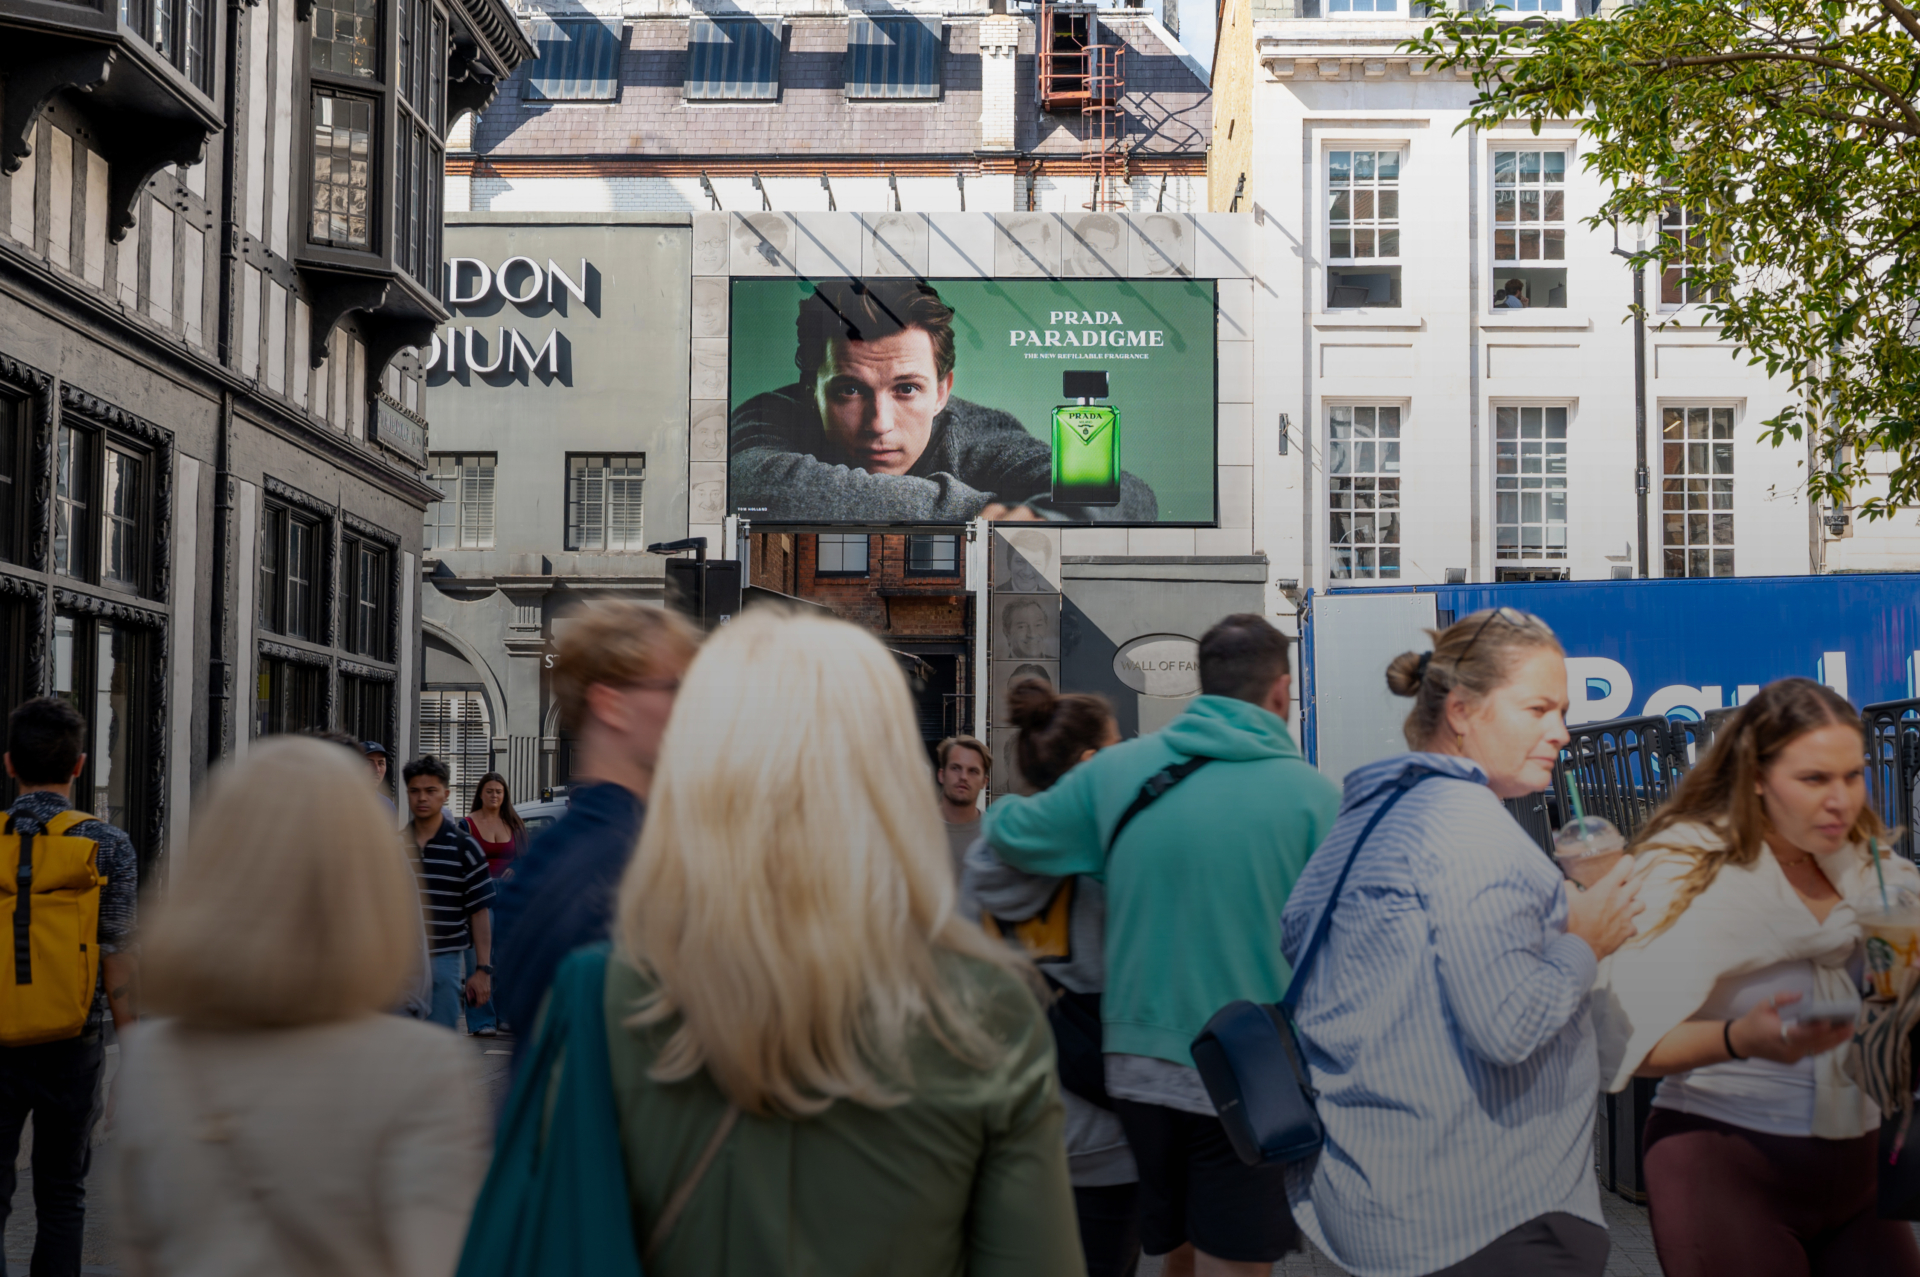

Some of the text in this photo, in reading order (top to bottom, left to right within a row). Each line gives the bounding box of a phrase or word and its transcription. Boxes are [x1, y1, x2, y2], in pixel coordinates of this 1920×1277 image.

[1050, 311, 1123, 325] PRADA
[1009, 330, 1164, 347] PARADIGME
[1121, 661, 1156, 671] WALL
[1158, 661, 1175, 671] OF
[1563, 651, 1848, 767] Pa
